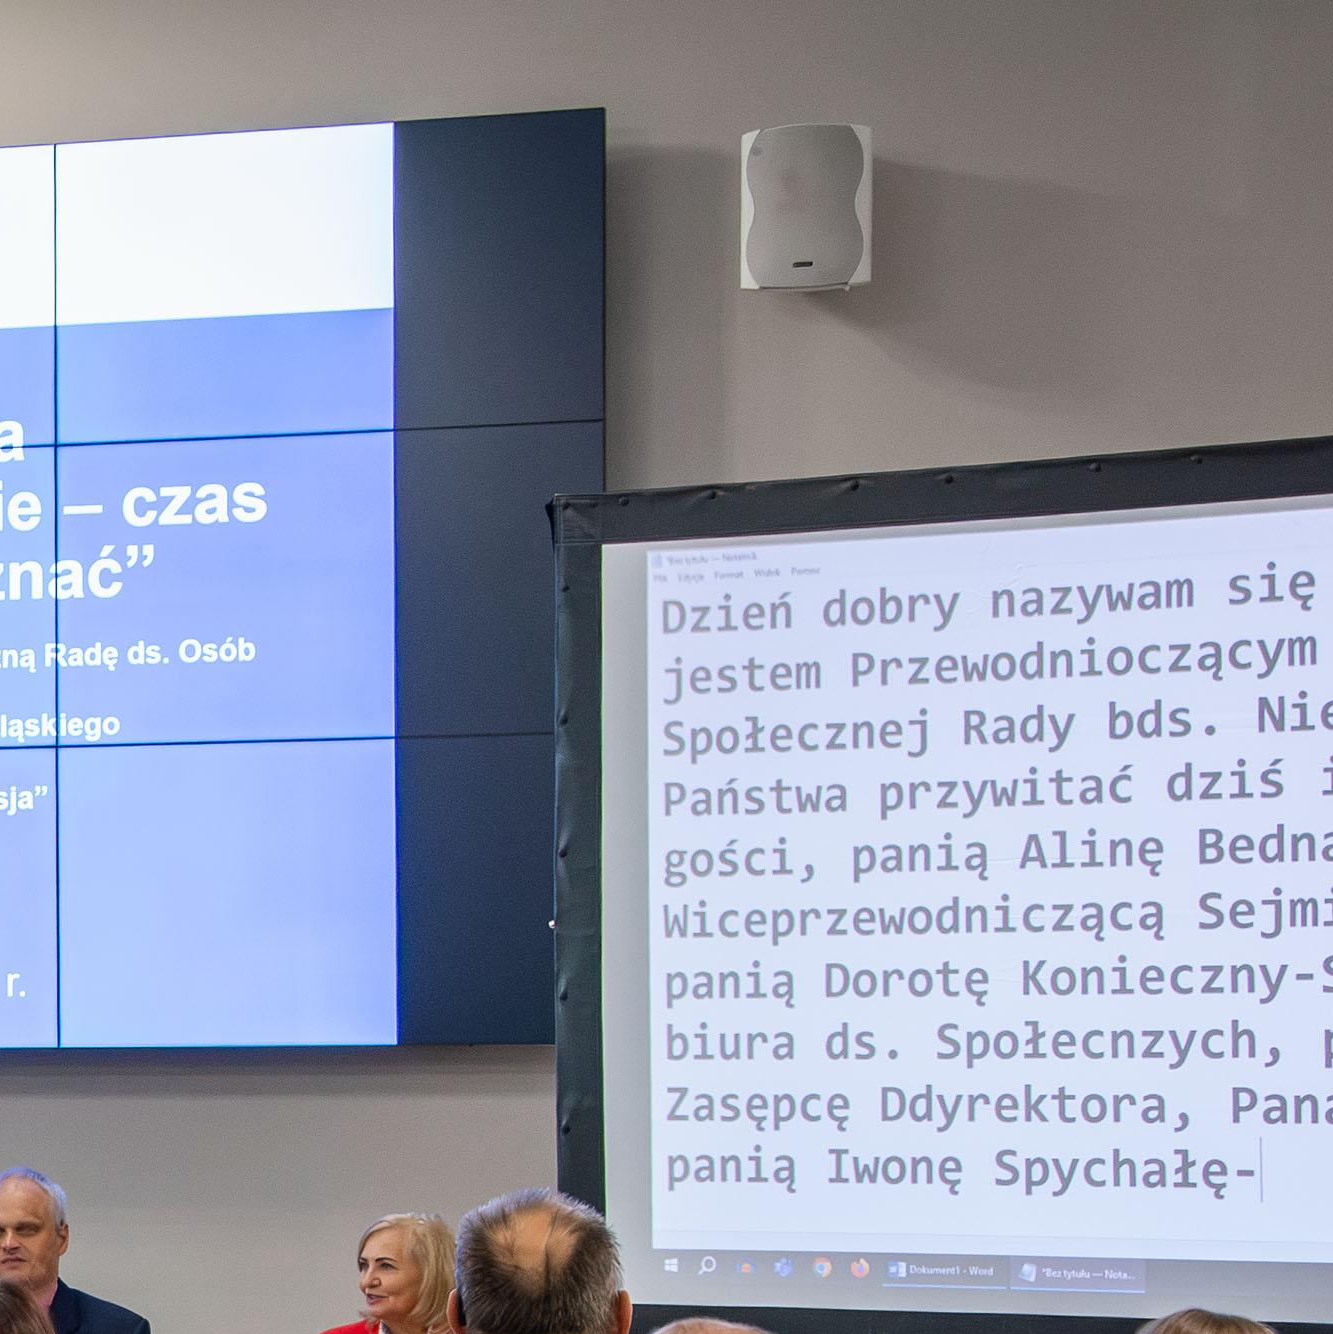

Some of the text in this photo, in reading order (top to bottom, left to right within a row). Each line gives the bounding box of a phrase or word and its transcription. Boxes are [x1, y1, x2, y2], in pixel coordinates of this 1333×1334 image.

[123, 483, 267, 526] czas
[663, 561, 1315, 633] Dzień dobry nazywam się
[45, 642, 118, 671] Radę
[128, 641, 169, 664] ds.
[179, 637, 255, 663] Osób
[664, 636, 1317, 704] jestem Przewodnioczącym
[664, 708, 927, 764] Społecznej
[964, 705, 1076, 752] Rady
[1109, 699, 1216, 739] bds.
[665, 778, 846, 816] Państwa
[881, 765, 1133, 820] przywitać
[1167, 758, 1283, 802] dziś
[665, 837, 814, 887] gości,
[853, 832, 988, 883] panią
[1019, 828, 1163, 877] Alinę
[664, 894, 1164, 946] Wiceprzewodniczącą
[7, 974, 25, 997] r.
[667, 960, 794, 1008] panią
[826, 961, 988, 1006] Dorotę
[668, 1022, 794, 1060] biura
[826, 1022, 898, 1060] ds.
[937, 1020, 1280, 1069] Społecnzych,
[668, 1088, 850, 1132] Zasępcę
[882, 1084, 1189, 1132] Ddyrektora,
[669, 1145, 1254, 1200] panią Iwonę Spychałę-
[909, 1264, 961, 1277] Dokument1
[969, 1265, 993, 1277] Word
